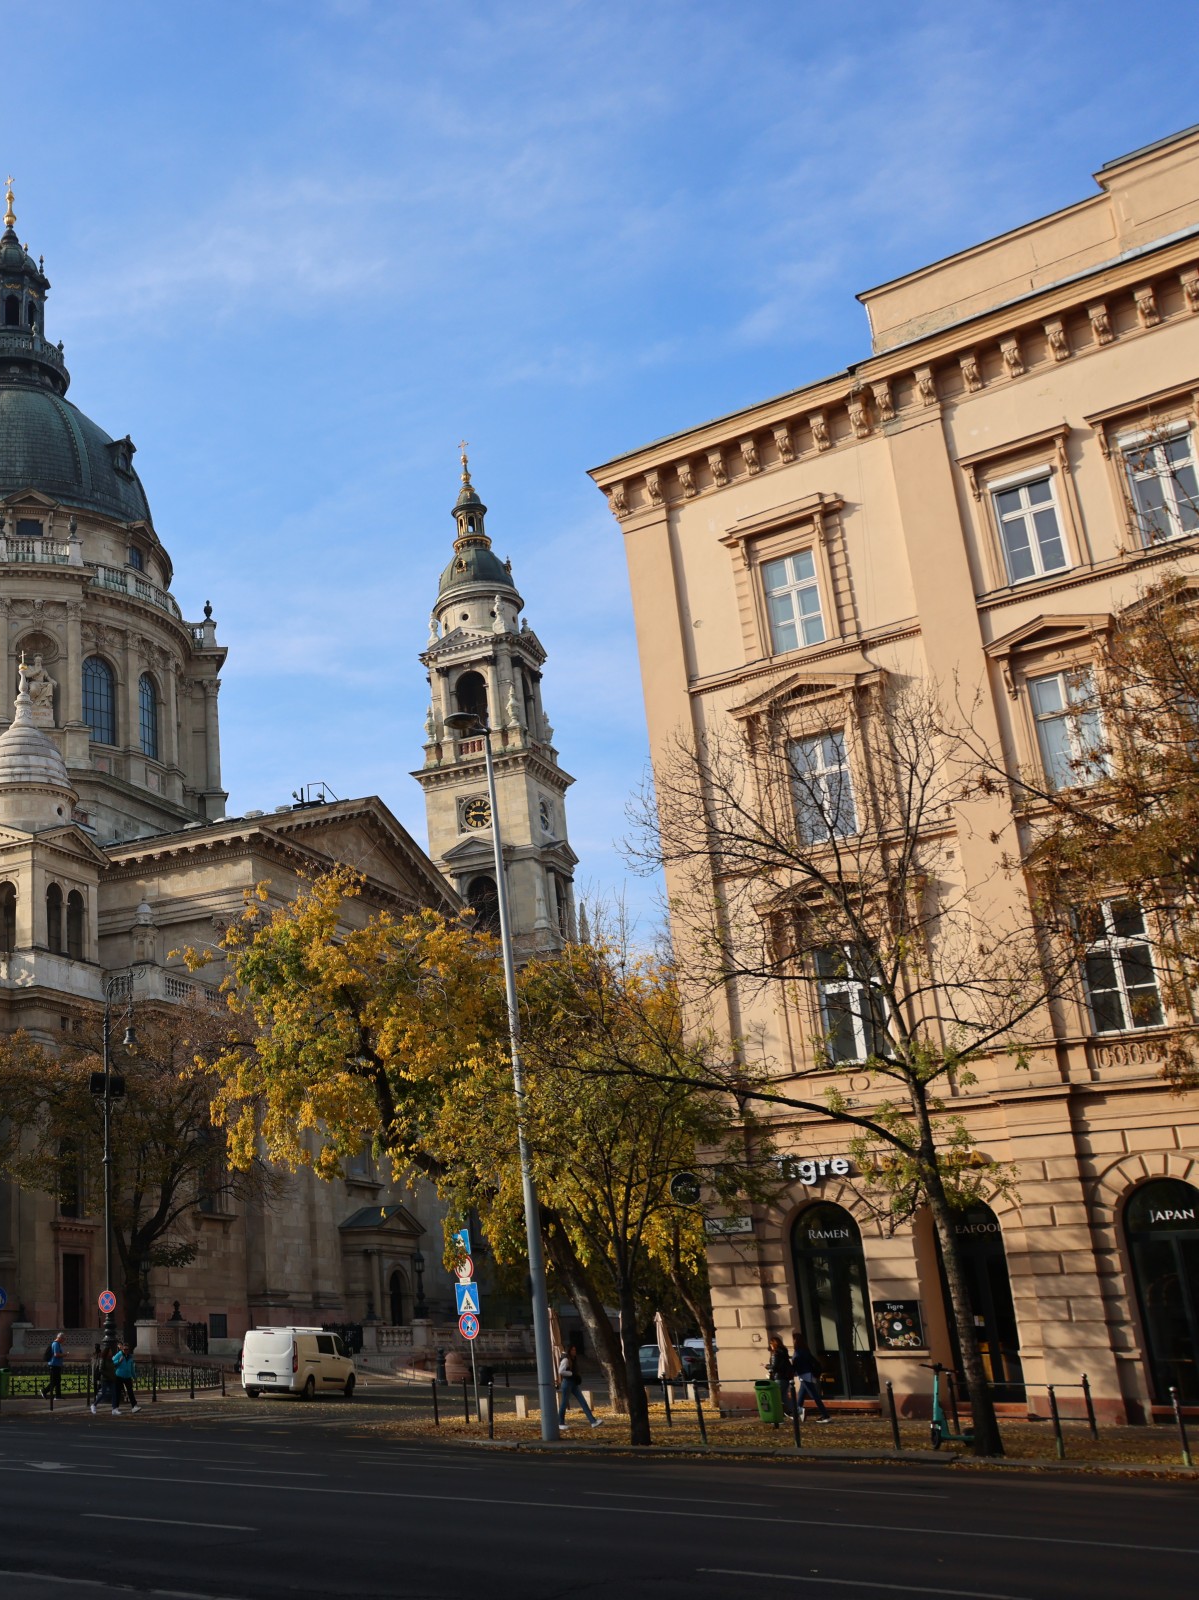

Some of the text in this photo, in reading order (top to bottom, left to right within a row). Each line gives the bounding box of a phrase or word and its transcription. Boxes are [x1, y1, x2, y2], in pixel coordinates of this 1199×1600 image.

[1149, 1208, 1196, 1224] JAPAN
[808, 1228, 849, 1239] RAMEN
[885, 1303, 904, 1311] Tigre
